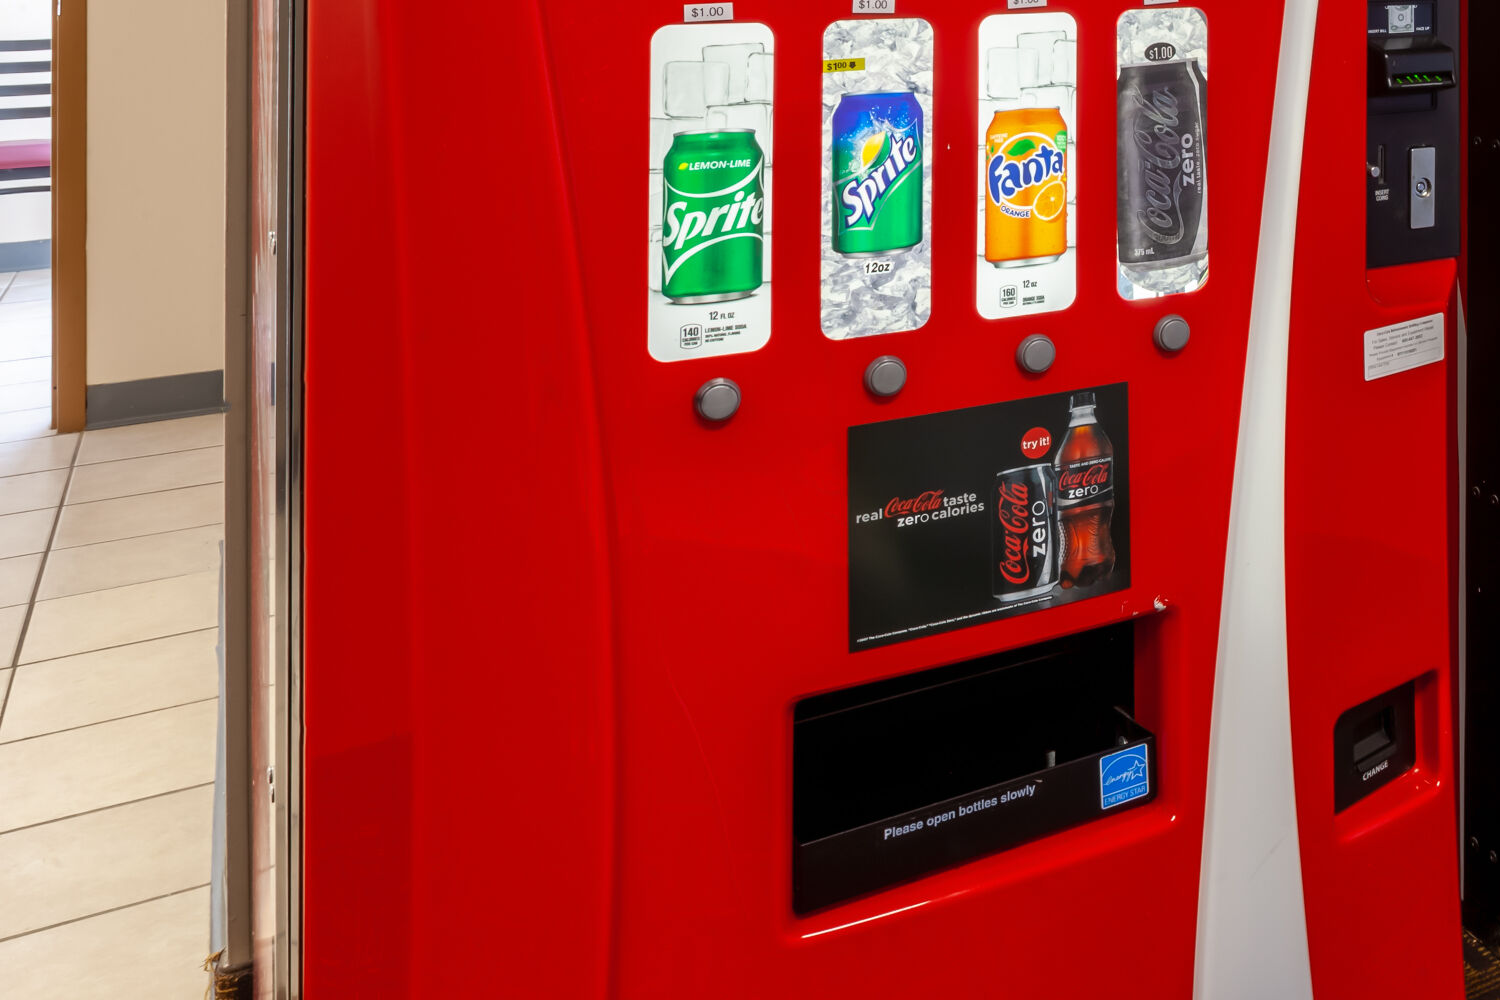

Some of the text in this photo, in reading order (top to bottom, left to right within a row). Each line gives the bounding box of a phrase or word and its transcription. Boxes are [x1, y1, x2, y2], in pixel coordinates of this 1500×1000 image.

[690, 5, 725, 18] $1.00
[858, 0, 888, 10] $1.00
[1148, 46, 1174, 60] $1.00
[688, 159, 752, 171] LEMON-LIME
[1132, 84, 1184, 245] Coca-Cola
[1180, 133, 1195, 187] zero
[842, 134, 917, 228] Sprite
[988, 145, 1064, 205] Fanta
[663, 191, 764, 251] Sprite
[1000, 205, 1030, 218] ORANGE
[865, 262, 891, 274] 12oz
[1002, 287, 1016, 297] 160
[1022, 279, 1030, 289] 12
[709, 310, 719, 321] 12
[683, 326, 699, 337] 140
[1022, 436, 1050, 450] try it!
[1059, 464, 1109, 491] Coca-Cola
[1068, 485, 1099, 499] zero
[856, 489, 977, 524] real Coca-Cola taste
[897, 502, 985, 528] zero calories
[998, 481, 1030, 584] Coca-Cola
[1032, 500, 1046, 558] zero
[1362, 759, 1389, 781] CHANGE
[1104, 785, 1146, 806] ENERGY STAR
[883, 784, 1037, 840] Please open bottles slowly
